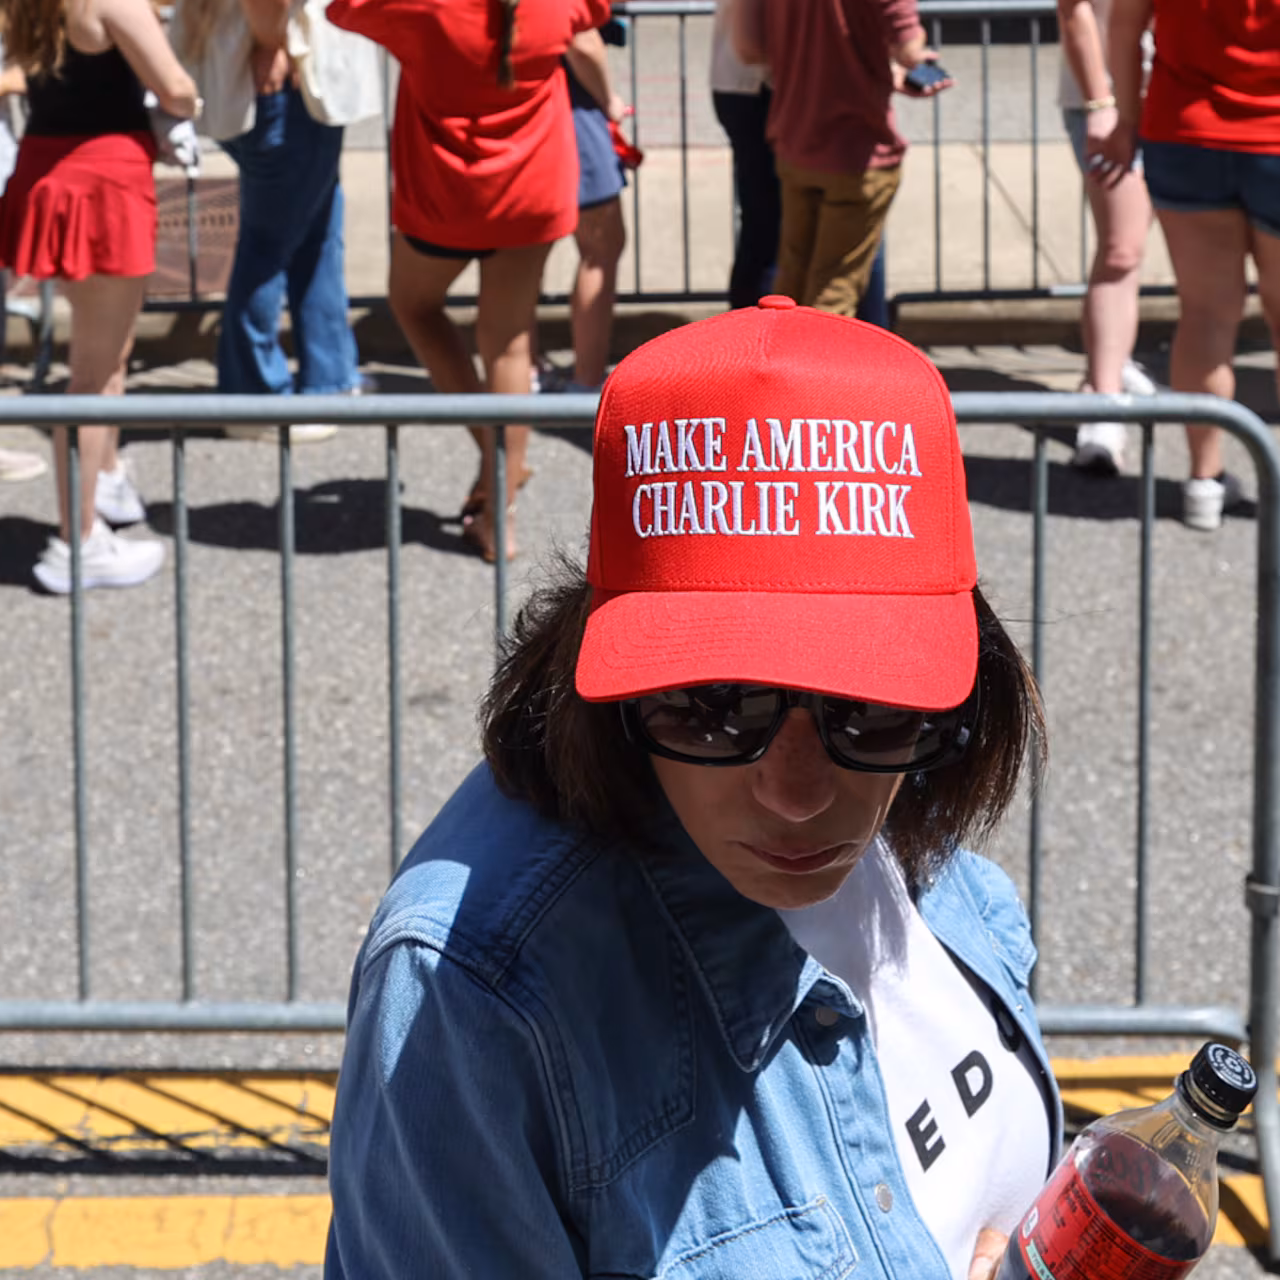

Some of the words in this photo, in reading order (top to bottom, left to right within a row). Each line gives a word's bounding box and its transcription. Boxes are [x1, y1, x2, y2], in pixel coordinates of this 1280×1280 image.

[624, 417, 727, 477] MAKE
[737, 417, 922, 478] AMERICA
[633, 480, 800, 538] CHARLIE
[813, 480, 913, 539] KIRK
